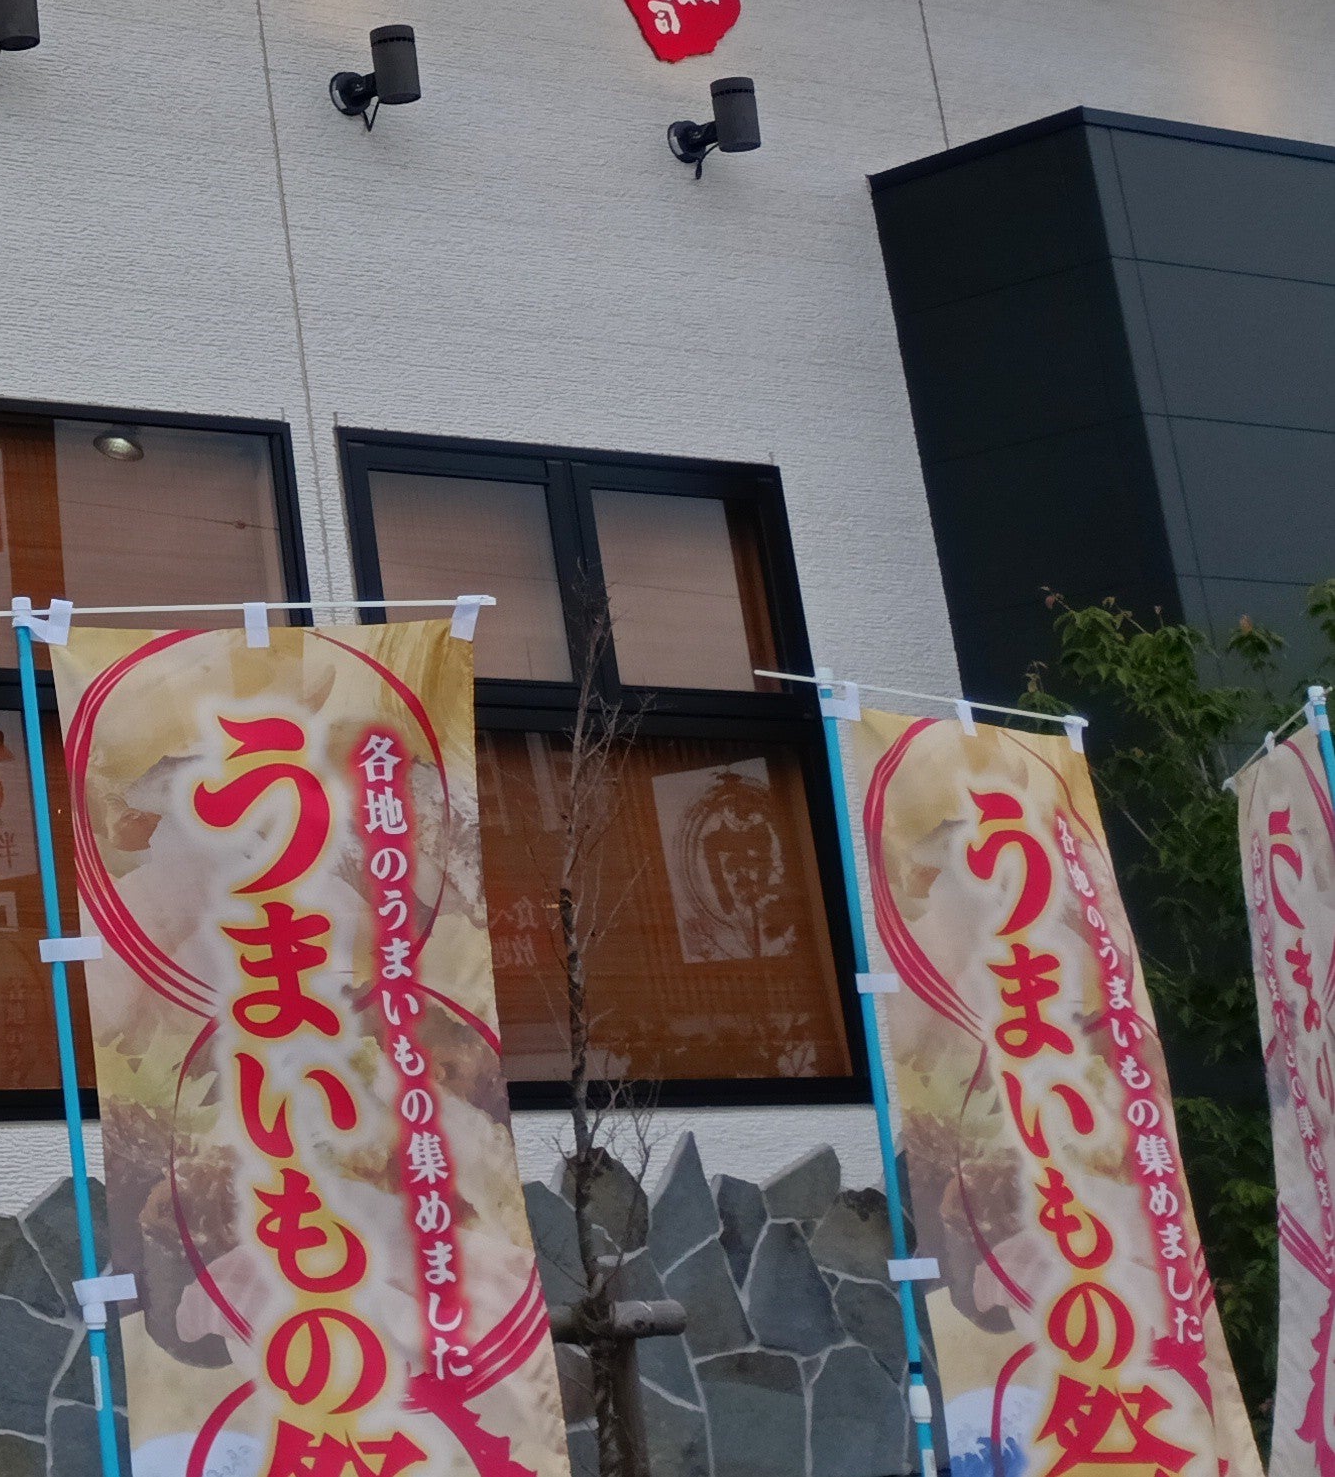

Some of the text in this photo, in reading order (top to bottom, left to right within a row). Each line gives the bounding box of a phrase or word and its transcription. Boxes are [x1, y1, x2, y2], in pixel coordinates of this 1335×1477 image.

[359, 734, 473, 1381] 各地のうまいもの集めました
[1057, 816, 1203, 1343] 各地のうまいもの集めました
